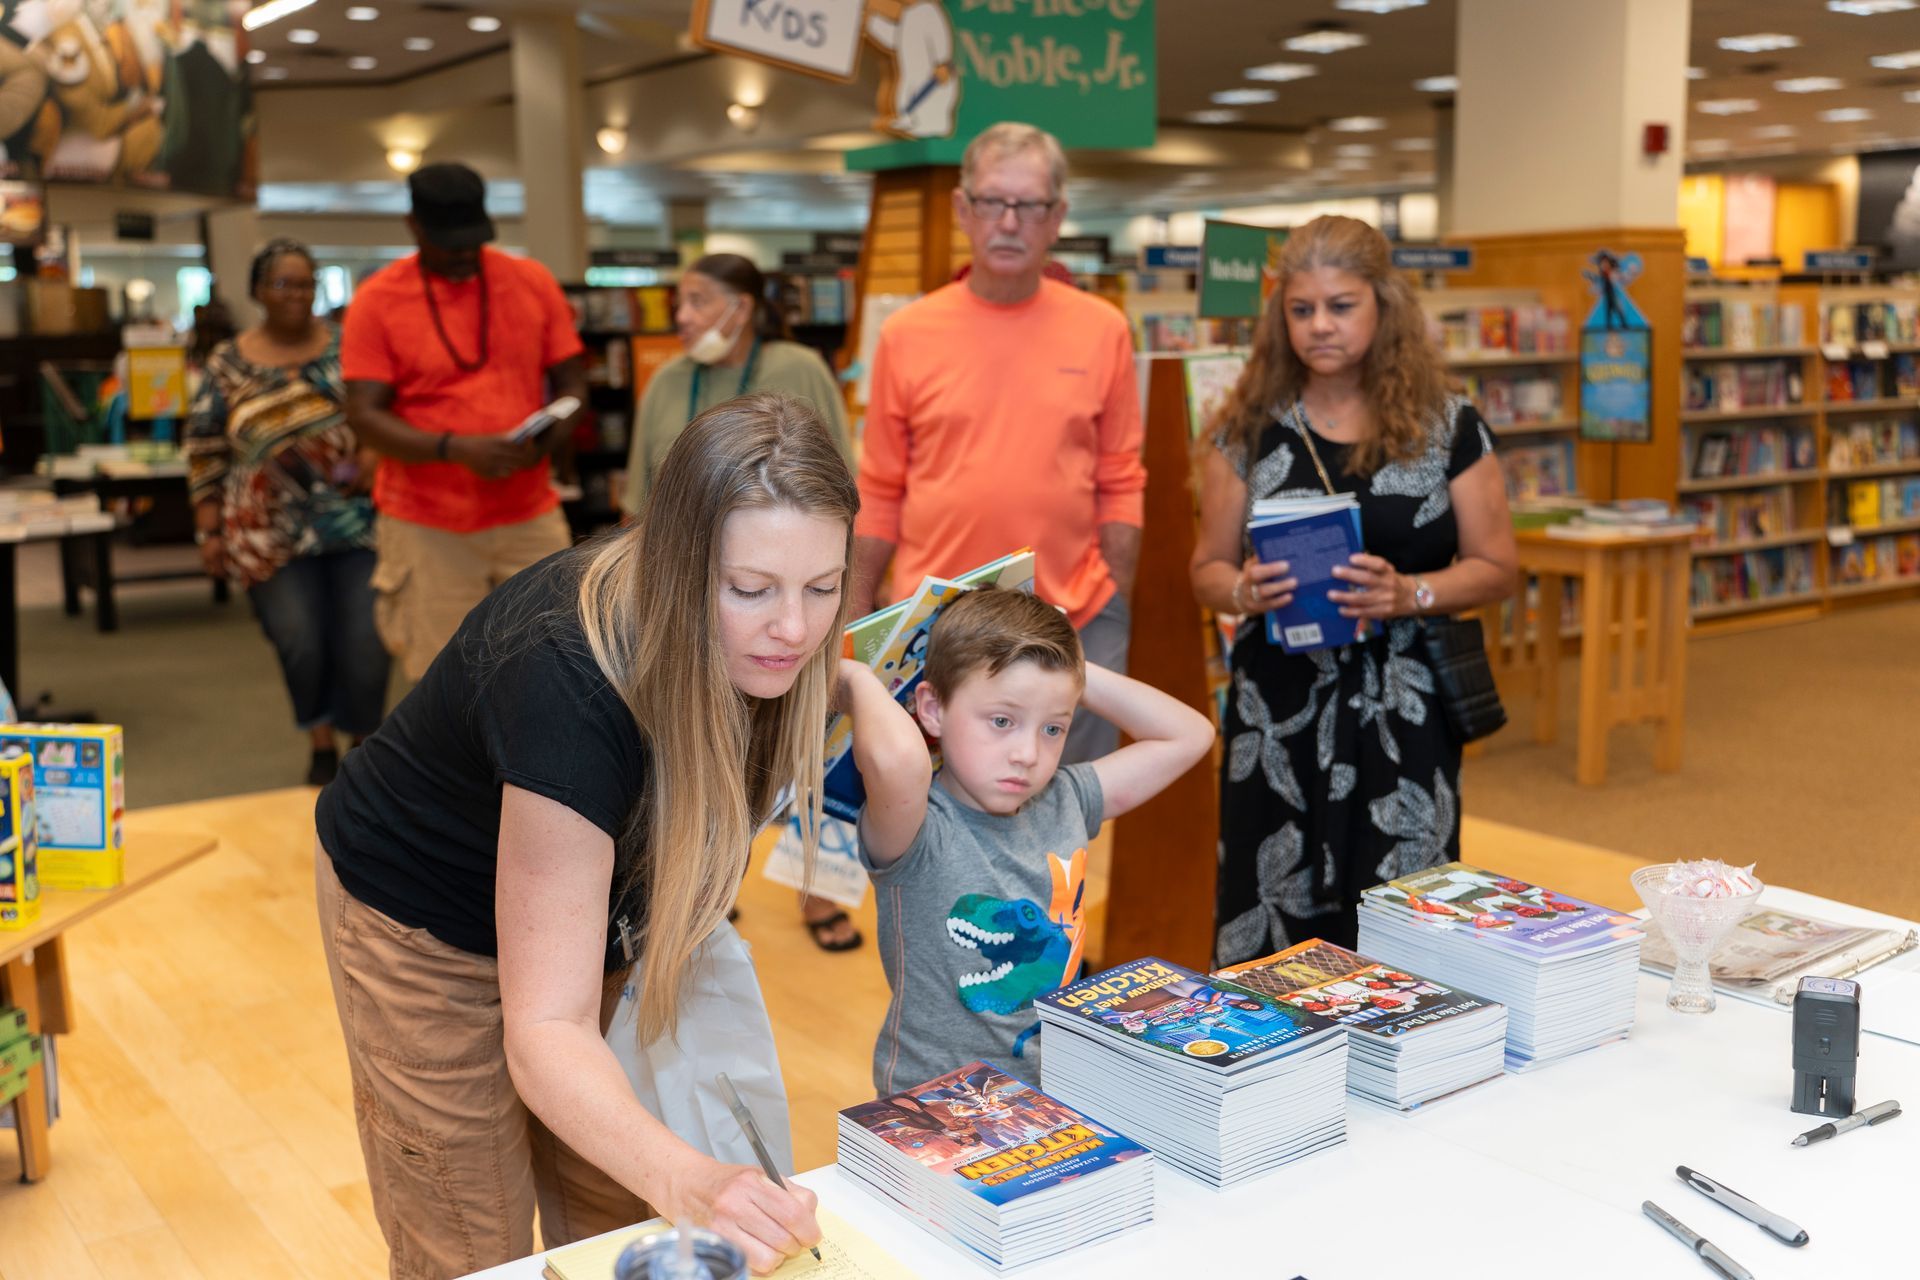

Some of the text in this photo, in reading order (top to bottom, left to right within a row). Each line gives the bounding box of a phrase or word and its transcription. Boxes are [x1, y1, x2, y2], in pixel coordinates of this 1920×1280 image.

[739, 0, 828, 47] KIDS
[958, 29, 1146, 94] Noble, Jr.
[1057, 962, 1174, 1008] Kitchen
[1080, 972, 1186, 1015] Mamaw Mel's
[1436, 1004, 1463, 1015] Like
[1459, 1000, 1482, 1010] Just
[1397, 1018, 1426, 1029] Dad
[1418, 1013, 1442, 1021] My
[1258, 1027, 1289, 1041] AUNTIE
[1268, 1025, 1315, 1044] ELIZABETH
[1372, 1025, 1407, 1036] 2
[1228, 1042, 1270, 1059] JOHNSON
[1234, 1039, 1261, 1050] NANN
[953, 1123, 1098, 1180] KITCHEN
[981, 1138, 1105, 1187] MAMAW MEL'S
[1022, 1156, 1100, 1186] ELIZABETH JOHNSON
[1029, 1158, 1080, 1179] AUNTIE NANN
